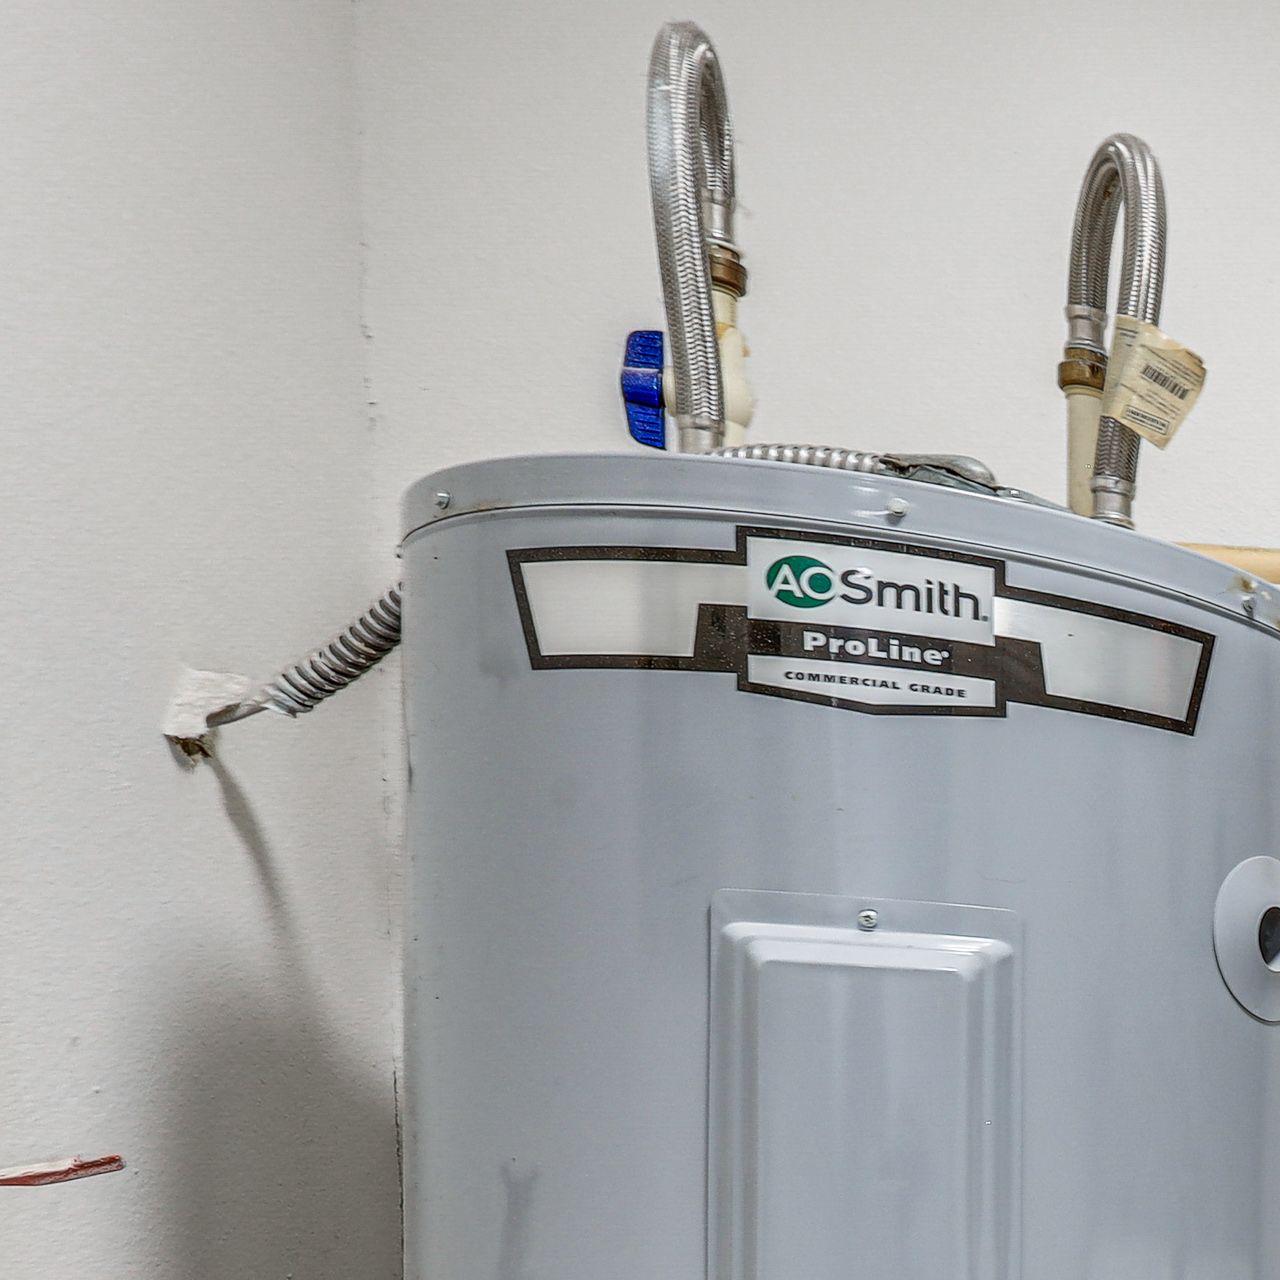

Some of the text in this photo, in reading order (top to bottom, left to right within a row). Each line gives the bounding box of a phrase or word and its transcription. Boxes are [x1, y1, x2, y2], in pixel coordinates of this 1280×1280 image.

[803, 630, 943, 666] ProLine
[784, 671, 967, 699] COMMERCIAL GRADE
